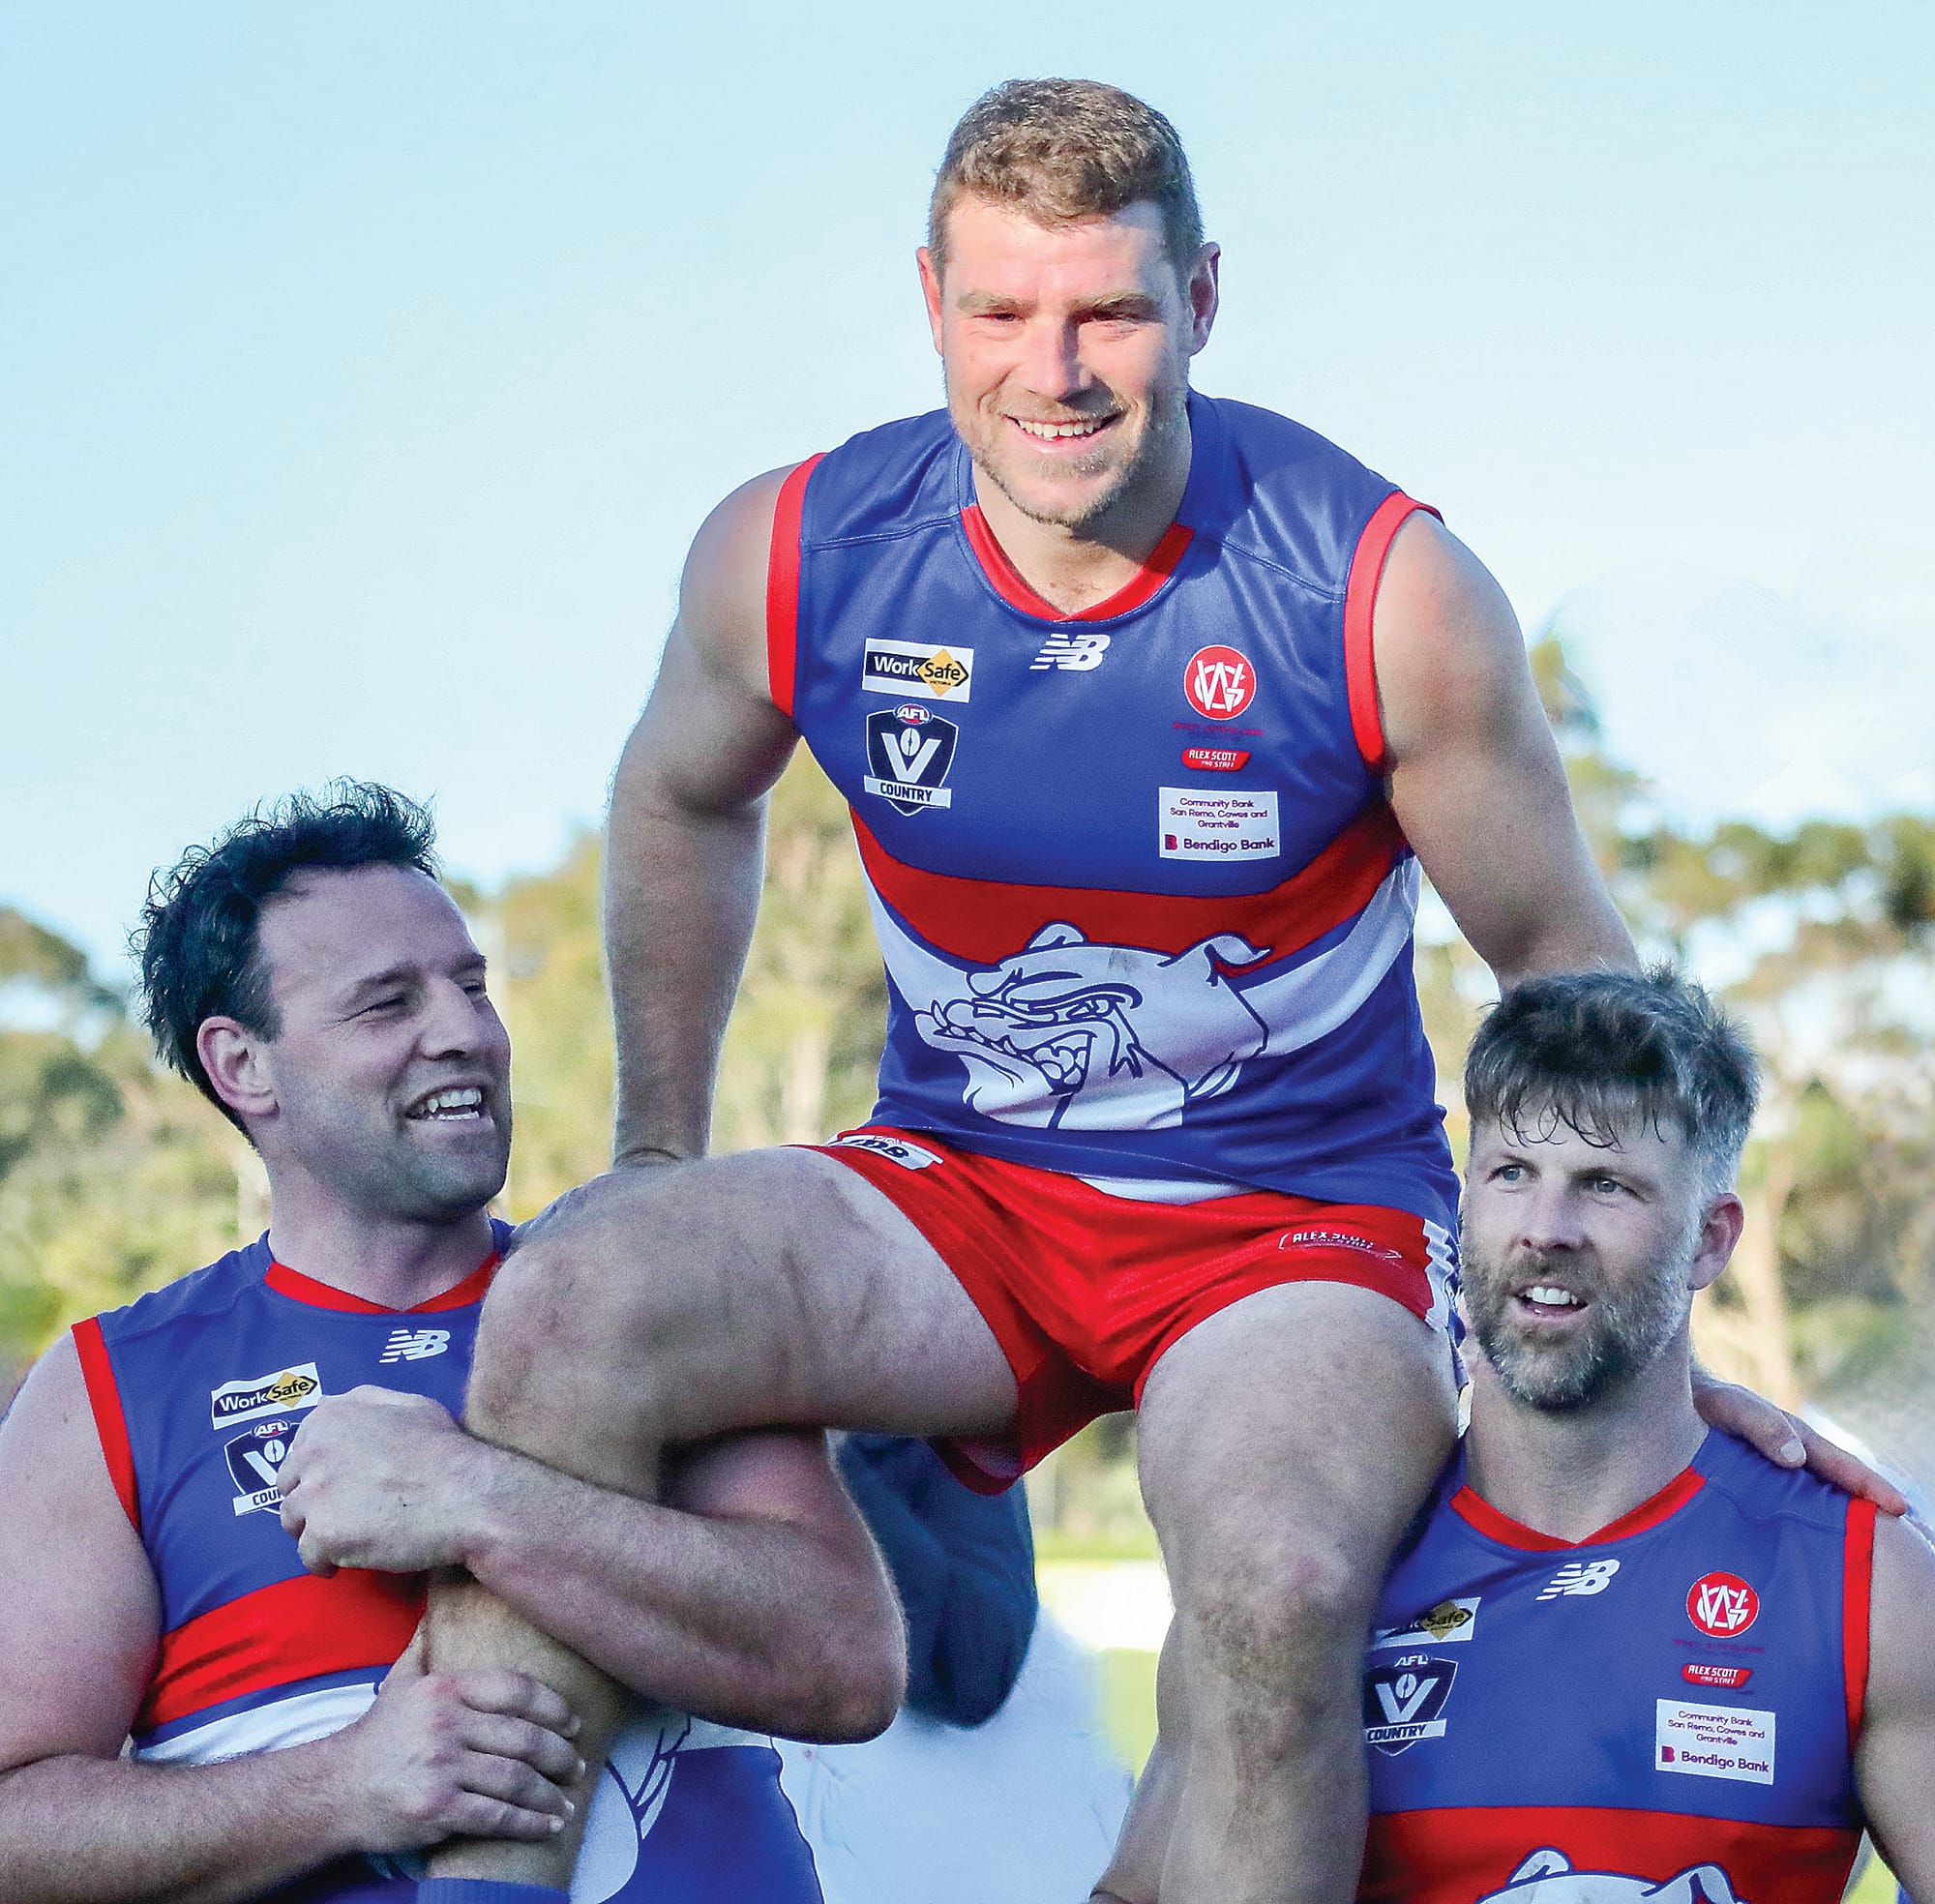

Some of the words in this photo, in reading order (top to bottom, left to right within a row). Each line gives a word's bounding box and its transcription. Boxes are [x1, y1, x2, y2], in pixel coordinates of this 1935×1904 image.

[897, 707, 929, 721] AFL
[1188, 750, 1210, 759] ALEX
[1211, 752, 1237, 761] SCOTT
[880, 782, 933, 802] COUNTRY
[1179, 797, 1230, 809] Community
[1232, 799, 1254, 808] Bank
[1170, 807, 1187, 816] San
[1188, 809, 1215, 818] Remo,
[1198, 819, 1239, 828] Grantville
[1183, 839, 1237, 853] Bendigo
[1240, 838, 1274, 850] Bank
[1293, 1232, 1327, 1243] ALEX
[255, 1421, 289, 1437] AFL
[1394, 1654, 1428, 1667] AFL
[1688, 1664, 1711, 1675] ALEX
[1712, 1666, 1739, 1678] SCOTT
[1678, 1711, 1729, 1725] Community
[1731, 1716, 1752, 1727] Bank
[1367, 1724, 1427, 1741] COUNTRY
[1668, 1719, 1684, 1729] San
[1687, 1721, 1715, 1733] Remo,
[1716, 1725, 1746, 1737] Cowes
[1748, 1730, 1765, 1739] and
[1696, 1733, 1738, 1745] Grantville
[1682, 1751, 1735, 1770] Bendigo
[1738, 1758, 1769, 1772] Bank
